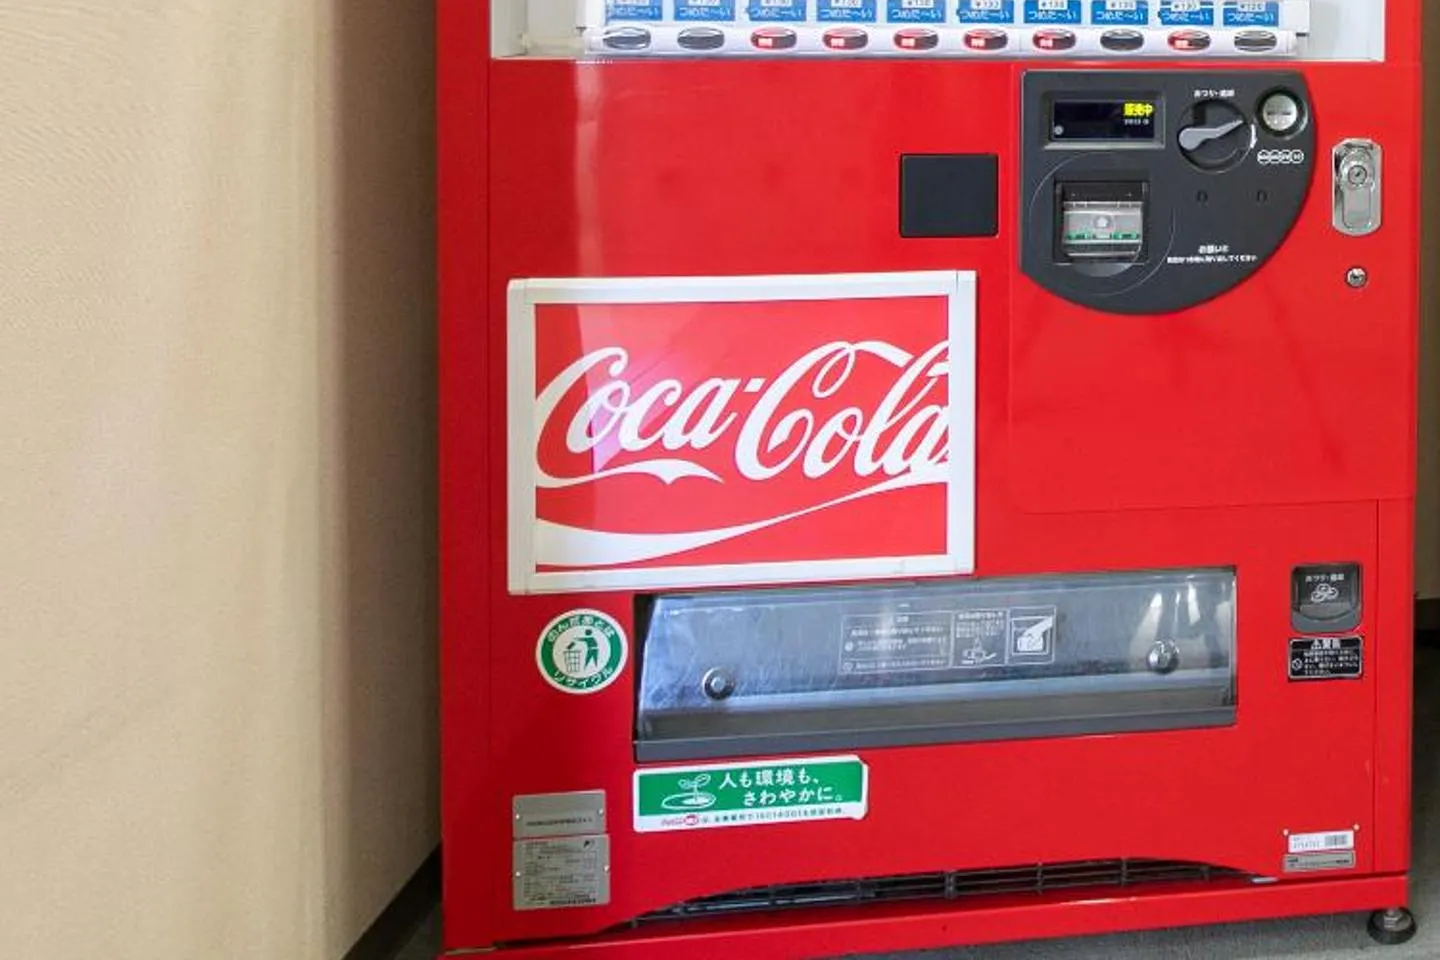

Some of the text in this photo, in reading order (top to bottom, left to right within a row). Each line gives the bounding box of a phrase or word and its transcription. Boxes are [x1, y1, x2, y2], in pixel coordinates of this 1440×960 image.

[535, 339, 950, 491] Coca-Cola
[718, 767, 820, 790] 人も環境も、
[743, 786, 844, 807] さわやかに。
